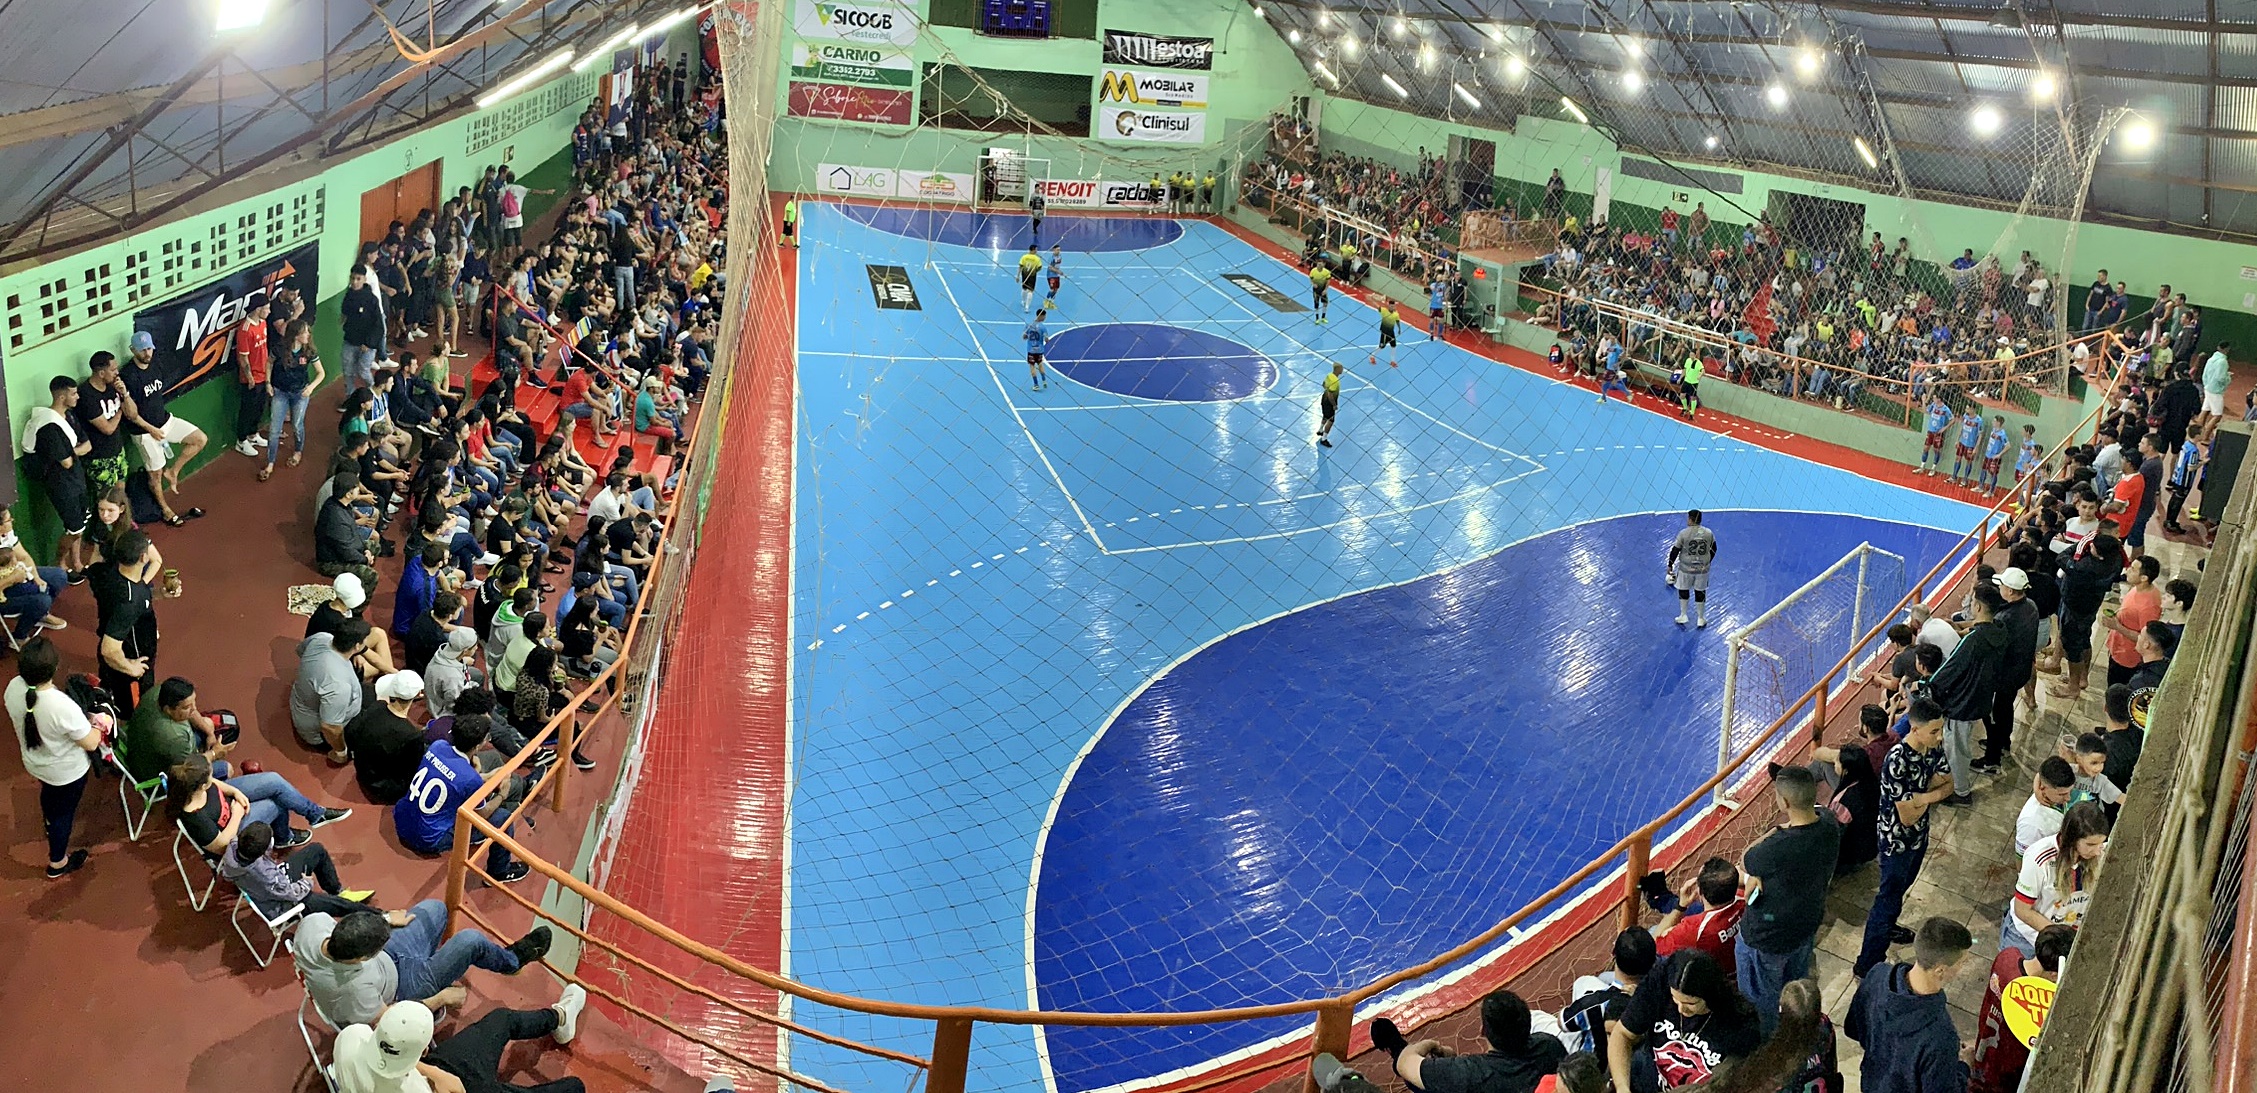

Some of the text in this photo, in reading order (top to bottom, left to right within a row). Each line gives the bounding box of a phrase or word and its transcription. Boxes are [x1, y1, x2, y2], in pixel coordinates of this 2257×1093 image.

[833, 9, 893, 29] SICOOB
[823, 46, 881, 62] CARMO
[1140, 79, 1194, 92] MOBILAR
[1142, 116, 1190, 131] Clinisul
[855, 173, 885, 187] LAG
[1039, 182, 1096, 197] BENOIT
[1688, 539, 1708, 556] 23
[409, 766, 448, 814] 40
[2010, 981, 2056, 1009] AQU
